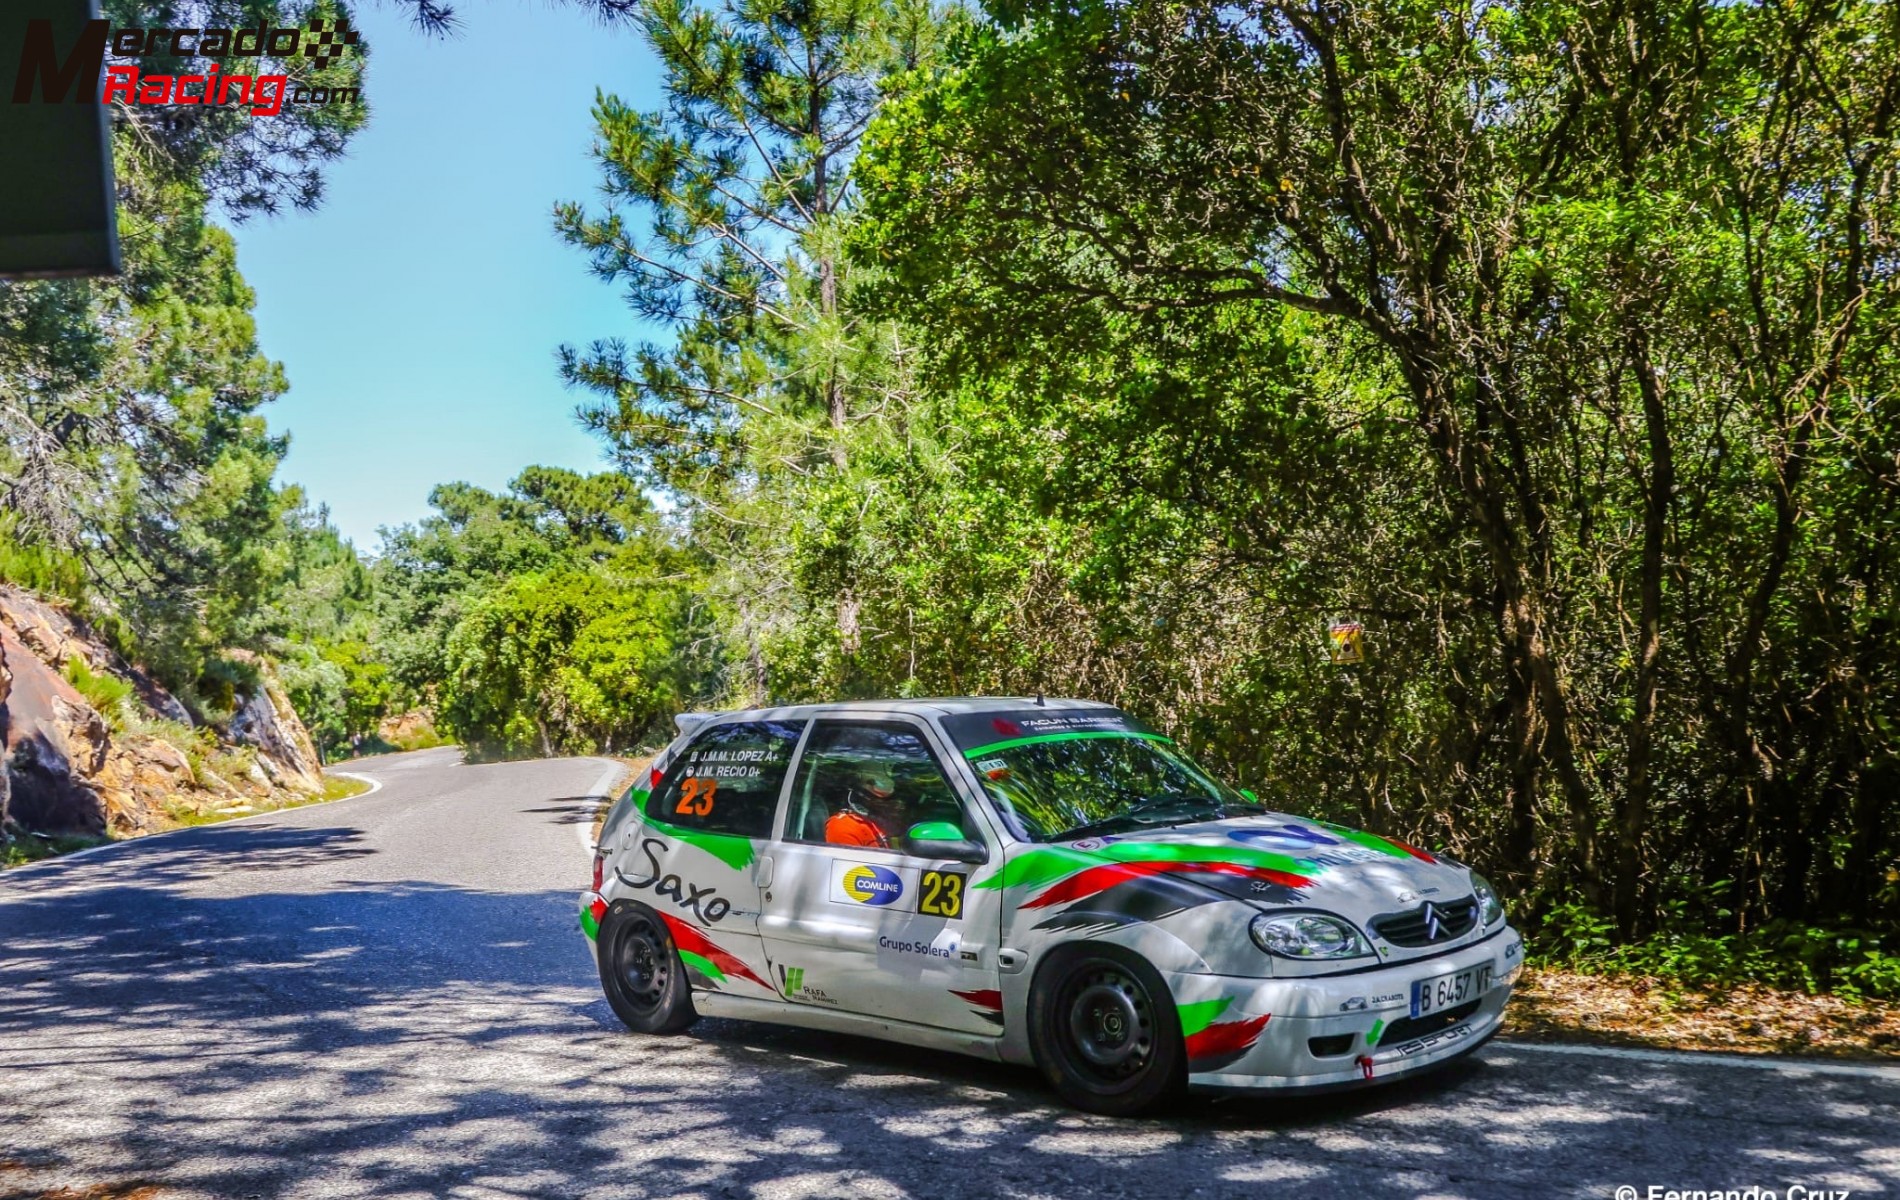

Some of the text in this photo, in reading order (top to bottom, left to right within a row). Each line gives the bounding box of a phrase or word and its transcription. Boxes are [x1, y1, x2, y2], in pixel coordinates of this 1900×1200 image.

[700, 750, 779, 761] J.M.M. LOPEZ A+
[696, 766, 714, 776] J.M.
[716, 766, 747, 776] RECIO
[676, 777, 717, 816] 23
[614, 838, 731, 927] Saxo
[856, 880, 898, 893] COMLINE
[922, 872, 961, 917] 23
[879, 936, 950, 958] Grupo Solera
[1422, 985, 1431, 1011] B
[1438, 972, 1471, 1006] 6457
